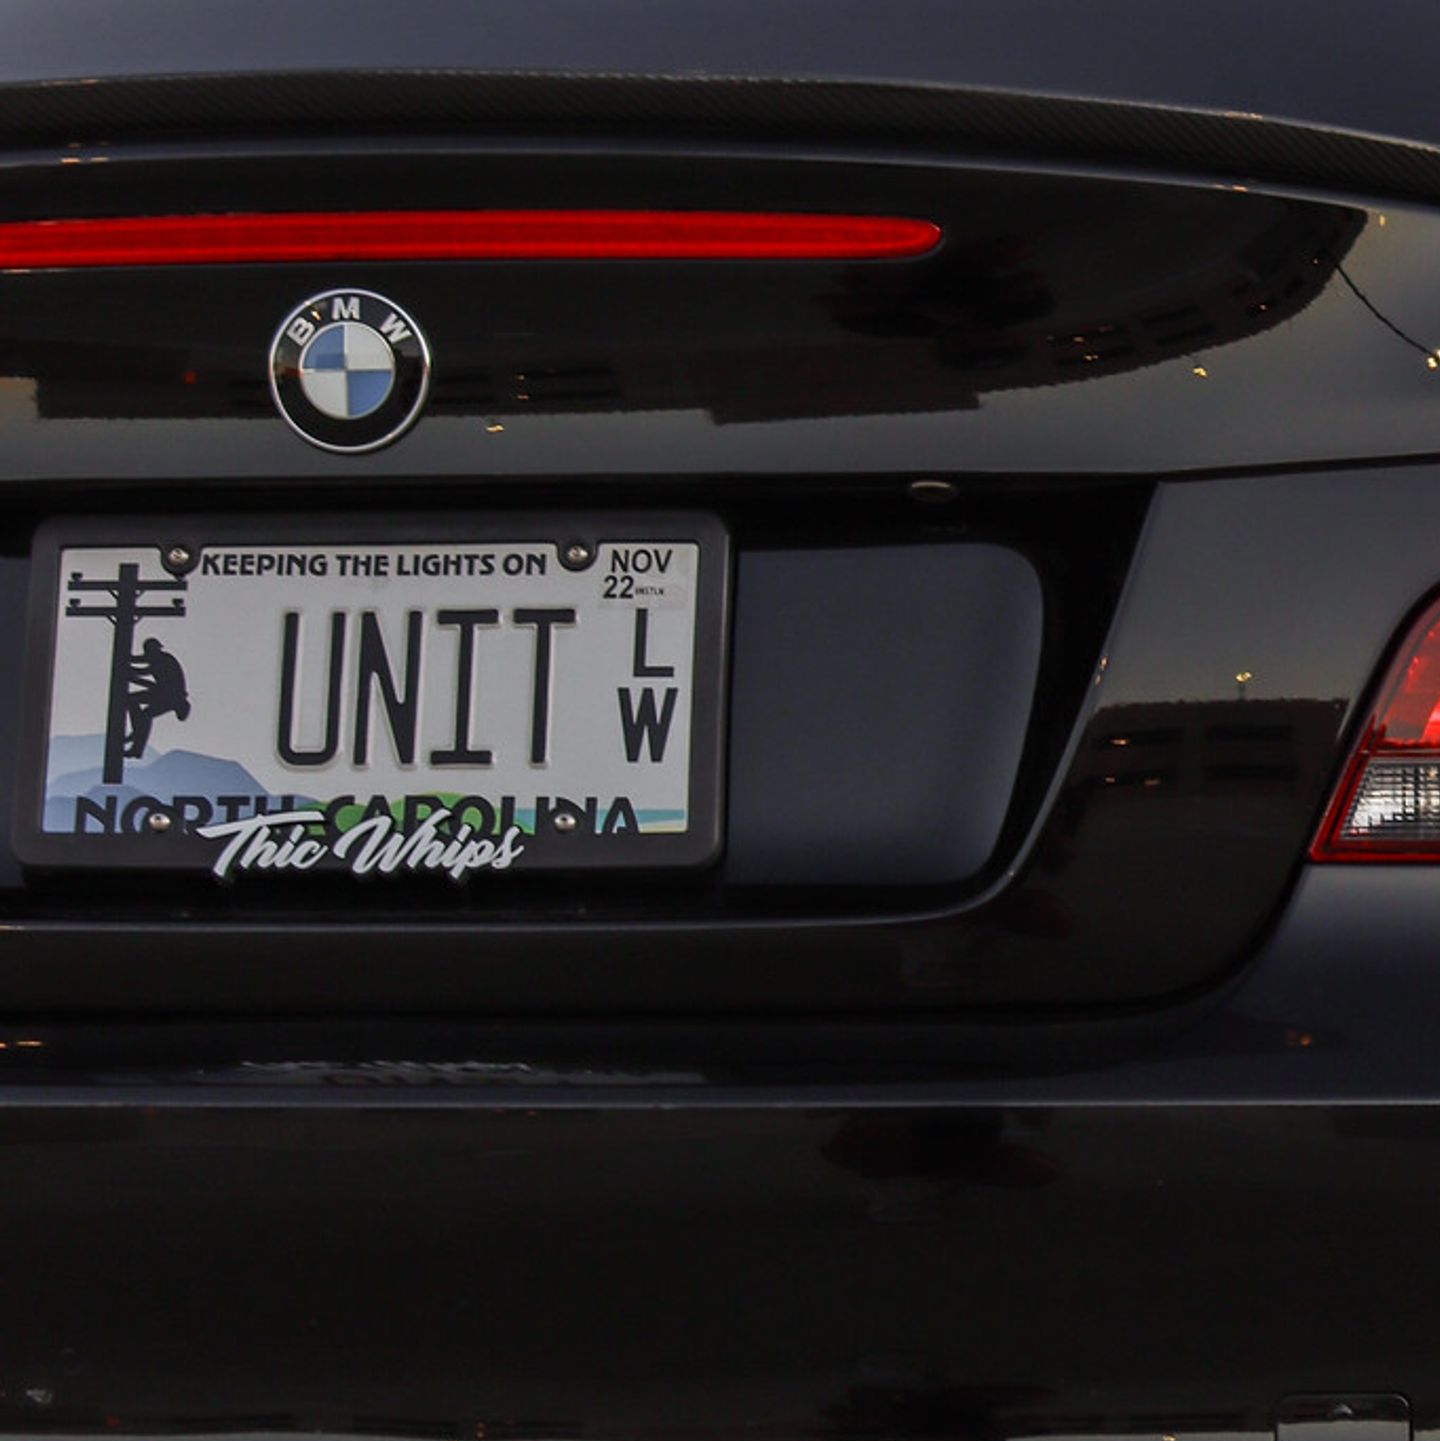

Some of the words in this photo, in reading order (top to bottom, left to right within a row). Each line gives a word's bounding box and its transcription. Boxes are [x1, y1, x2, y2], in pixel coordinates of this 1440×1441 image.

[286, 296, 412, 347] BMW
[202, 553, 327, 577] KEEPING
[336, 554, 389, 577] THE
[397, 554, 495, 577] LIGHTS
[502, 553, 547, 576] ON
[611, 548, 673, 574] NOV
[603, 575, 635, 600] 22
[276, 607, 577, 767] UNIT
[196, 810, 329, 878] Thic
[332, 809, 525, 880] Whips
